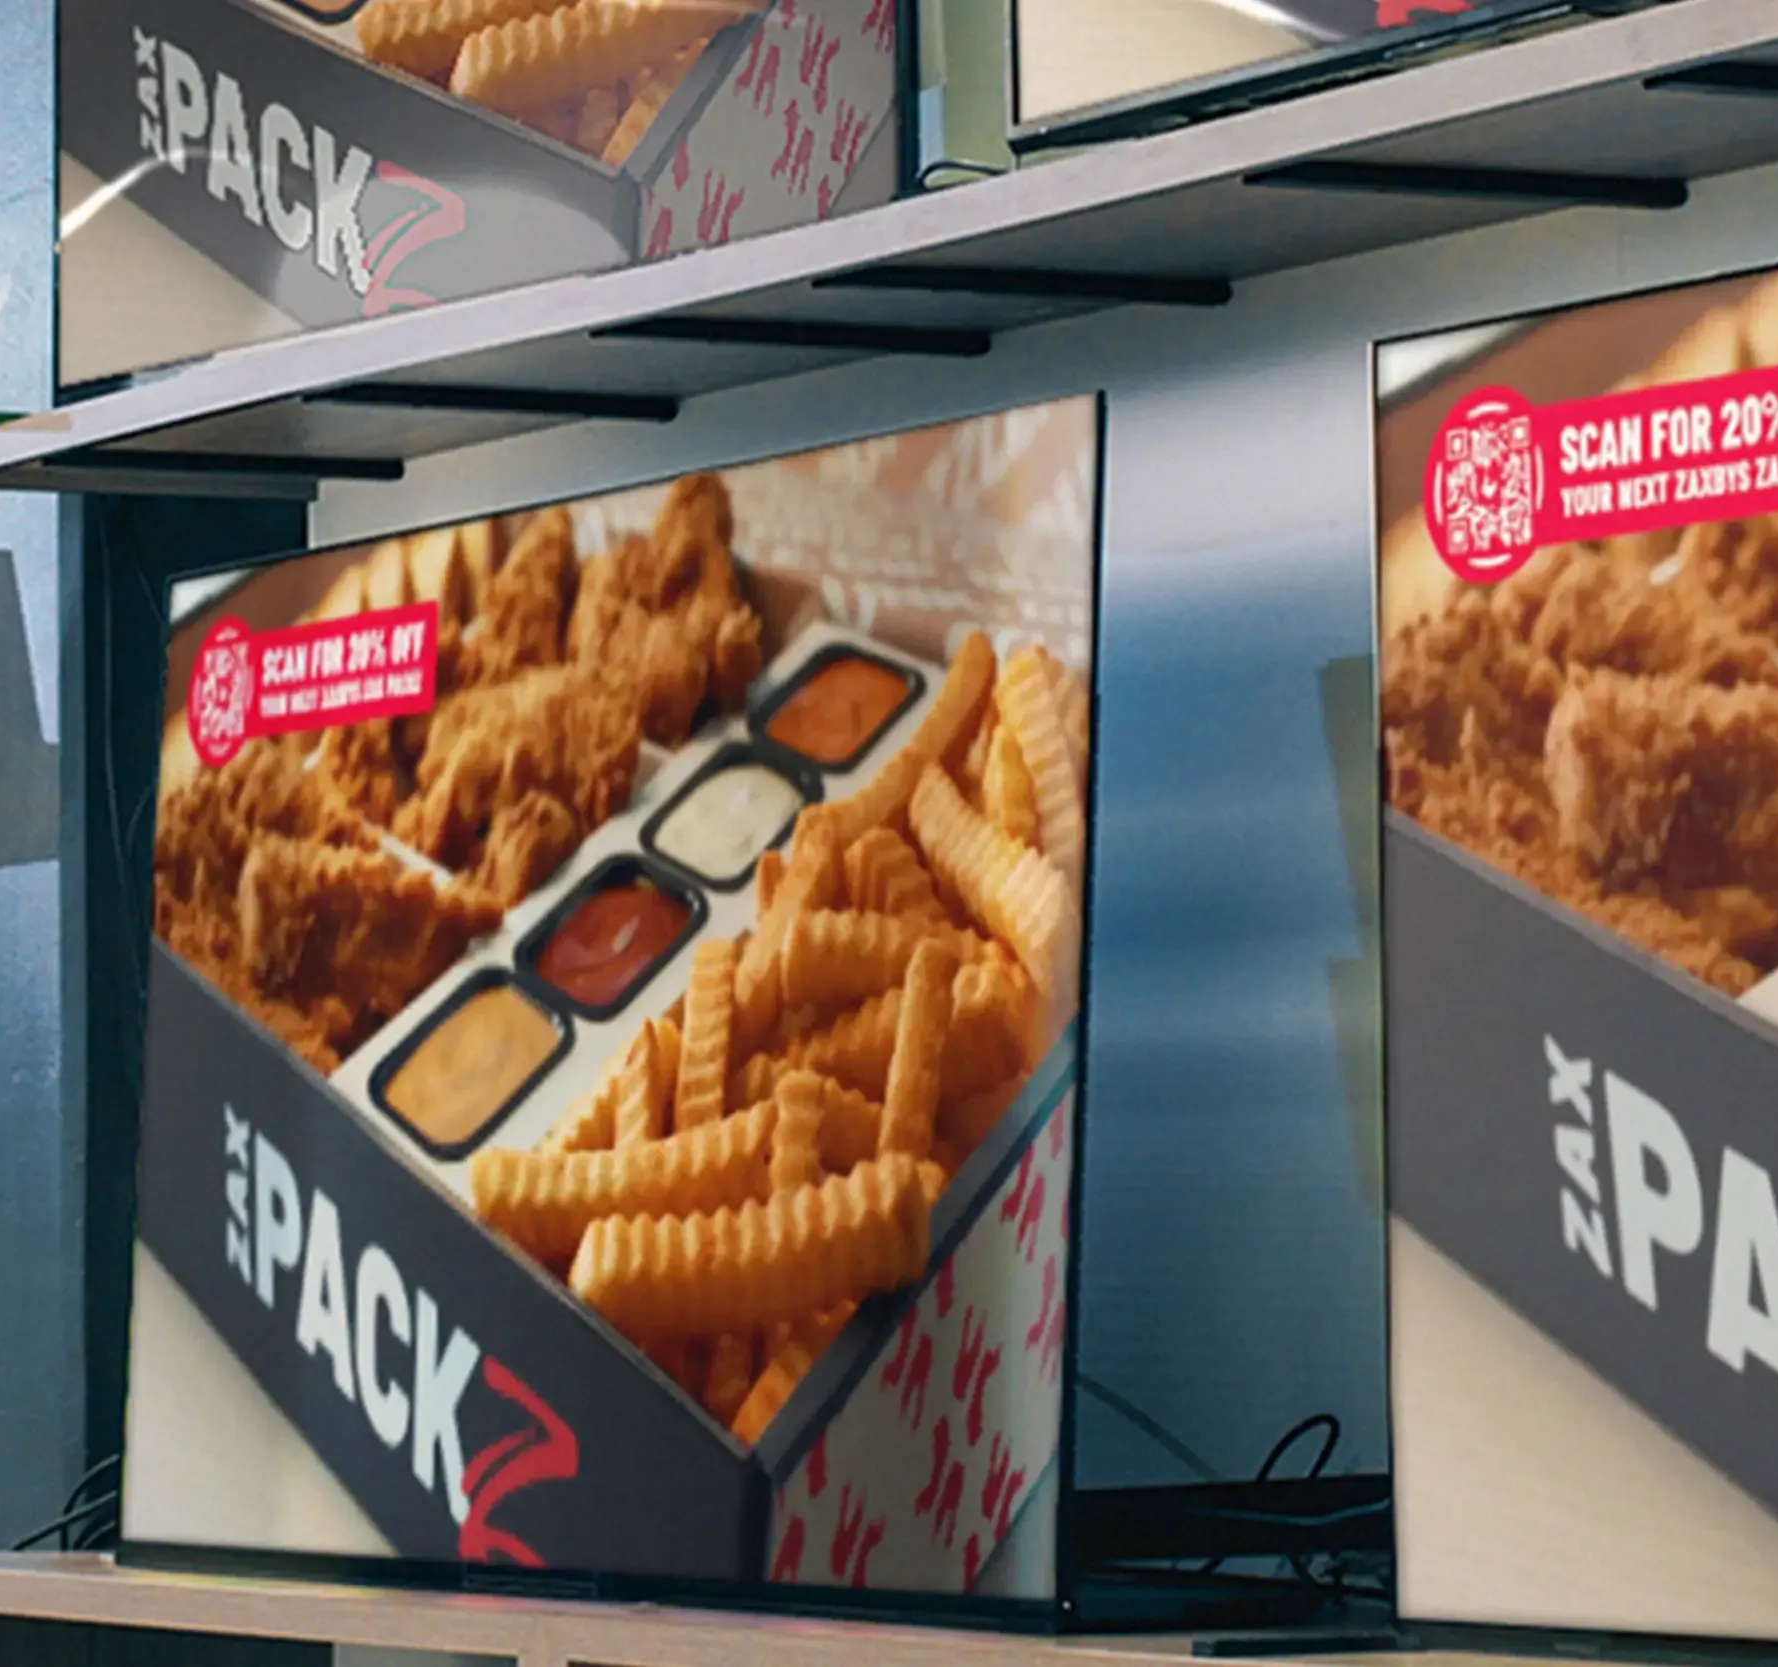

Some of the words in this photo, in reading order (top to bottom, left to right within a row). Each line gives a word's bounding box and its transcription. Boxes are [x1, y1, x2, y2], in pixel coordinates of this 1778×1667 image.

[132, 25, 166, 161] ZAX
[1559, 415, 1642, 475] SCAN
[1650, 405, 1714, 461] FOR
[1559, 481, 1613, 519] YOUR
[1617, 473, 1669, 512] NEXT
[1673, 462, 1752, 502] ZAXBYS
[263, 642, 309, 686] SCAN
[311, 634, 346, 680] FOR
[390, 620, 427, 666] OFF
[224, 1102, 252, 1285] ZAX
[1543, 1032, 1614, 1278] ZAX
